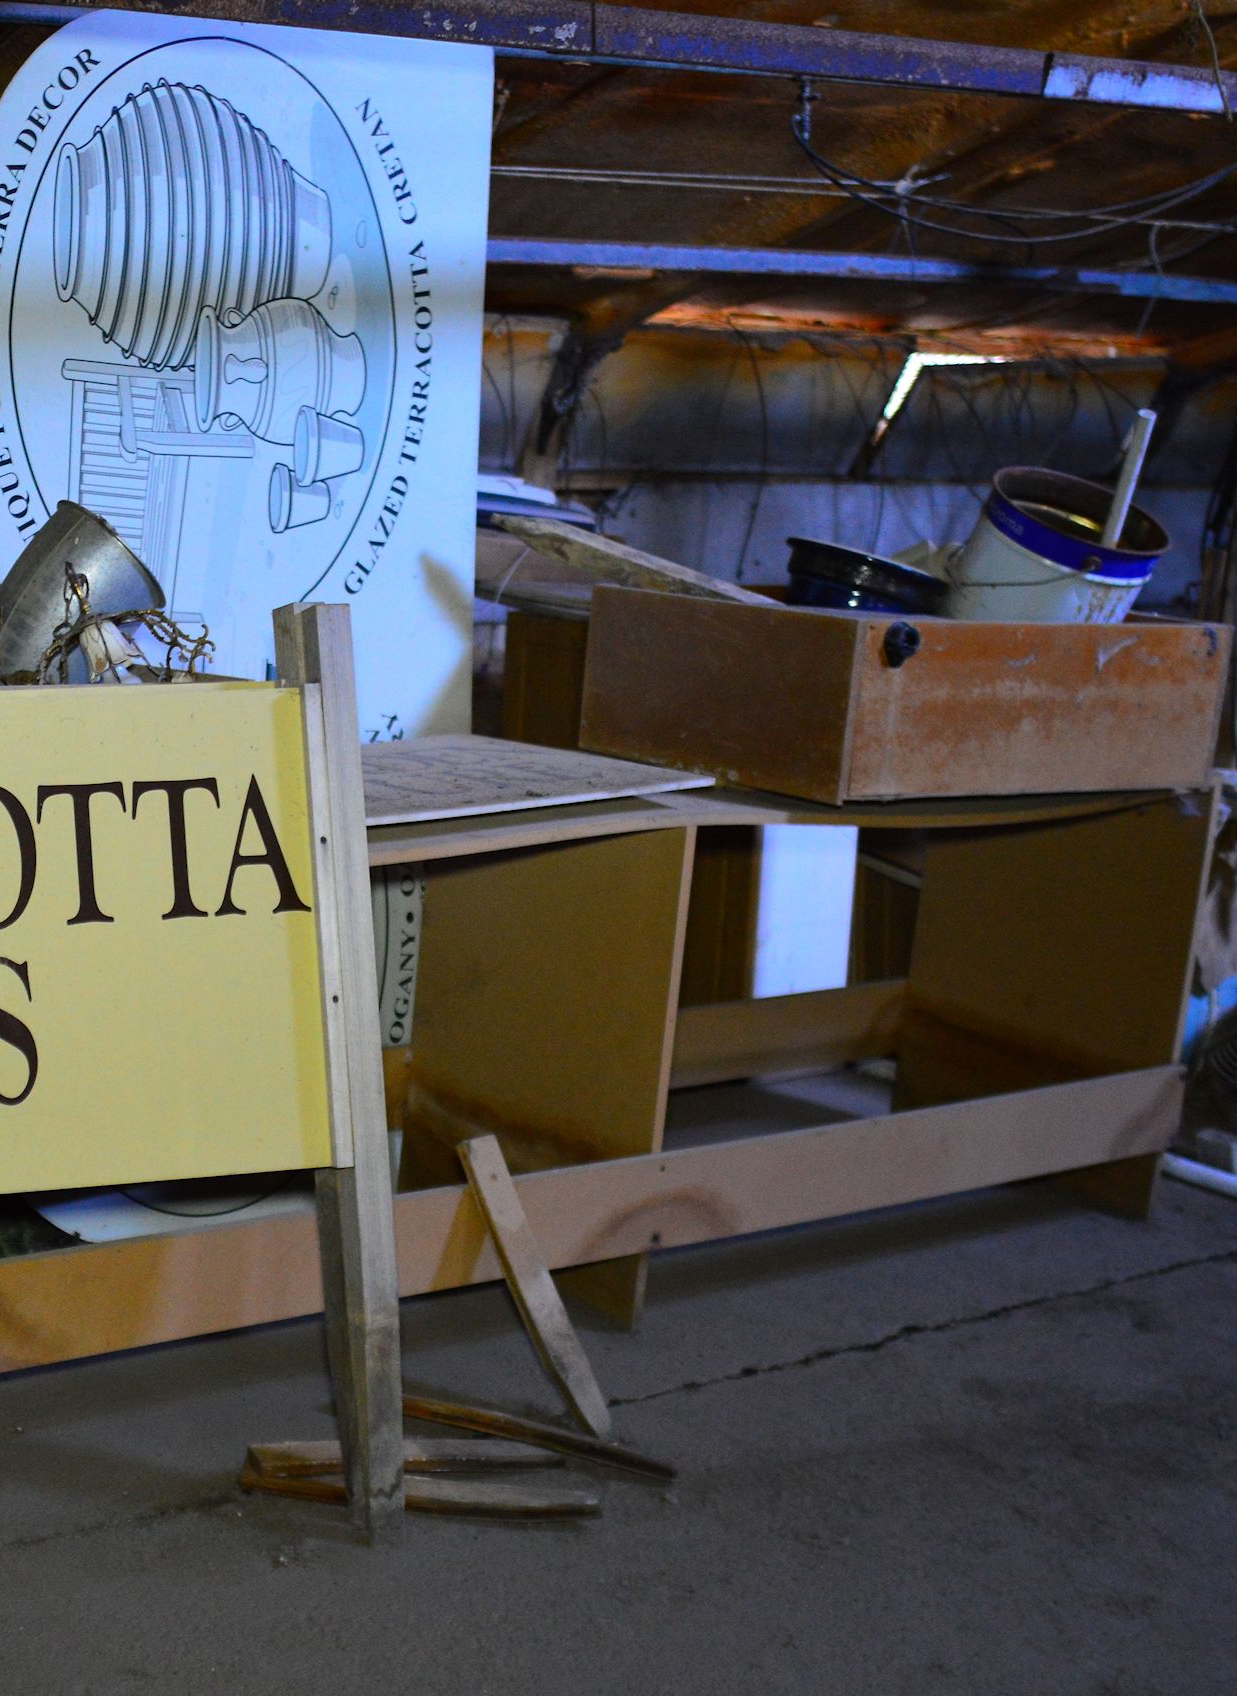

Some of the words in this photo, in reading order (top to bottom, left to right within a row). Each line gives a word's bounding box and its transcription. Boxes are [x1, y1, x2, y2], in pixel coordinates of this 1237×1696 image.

[14, 48, 101, 154] DECOR
[355, 97, 419, 226] CRETAN
[398, 240, 433, 464] TERRACOTTA
[344, 475, 409, 596] GLAZED
[388, 930, 416, 1044] OGANY
